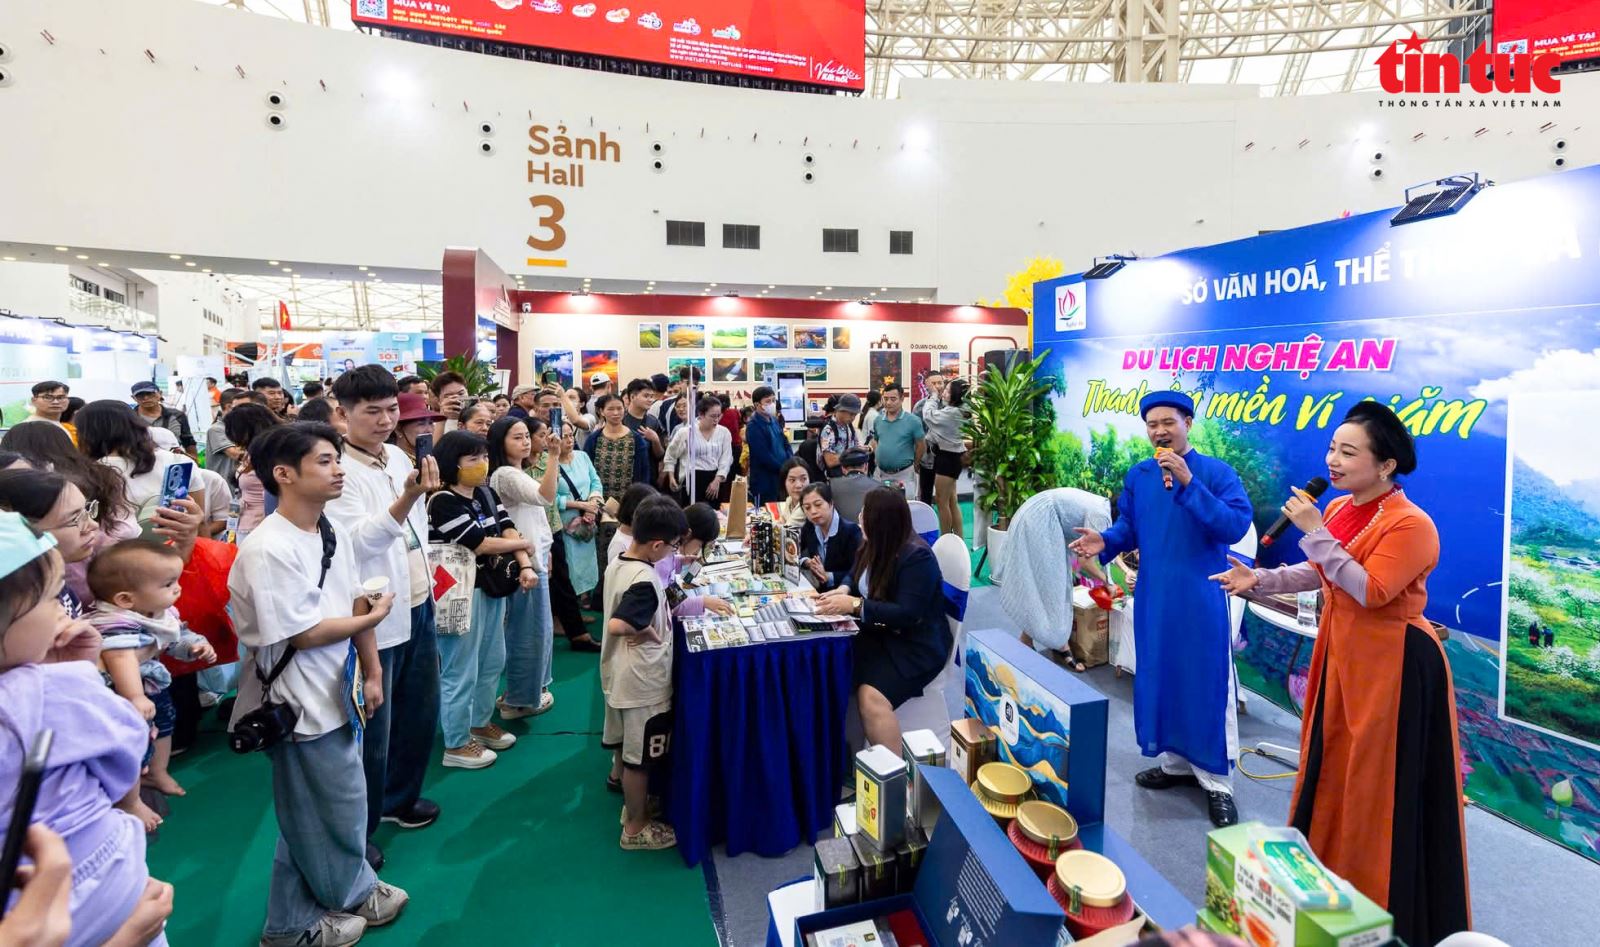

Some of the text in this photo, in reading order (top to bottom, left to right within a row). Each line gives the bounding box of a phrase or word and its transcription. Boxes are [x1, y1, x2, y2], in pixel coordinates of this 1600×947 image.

[1534, 37, 1559, 47] MUA
[1577, 32, 1596, 42] TẠI
[528, 124, 621, 162] Sảnh
[527, 160, 584, 188] Hall
[526, 194, 567, 252] 3
[1213, 272, 1257, 302] VĂN
[1264, 258, 1328, 296] HOÁ,
[1334, 241, 1392, 287] THỂ
[1121, 332, 1398, 379] DU LỊCH NGHỆ AN
[1206, 375, 1288, 425] miền
